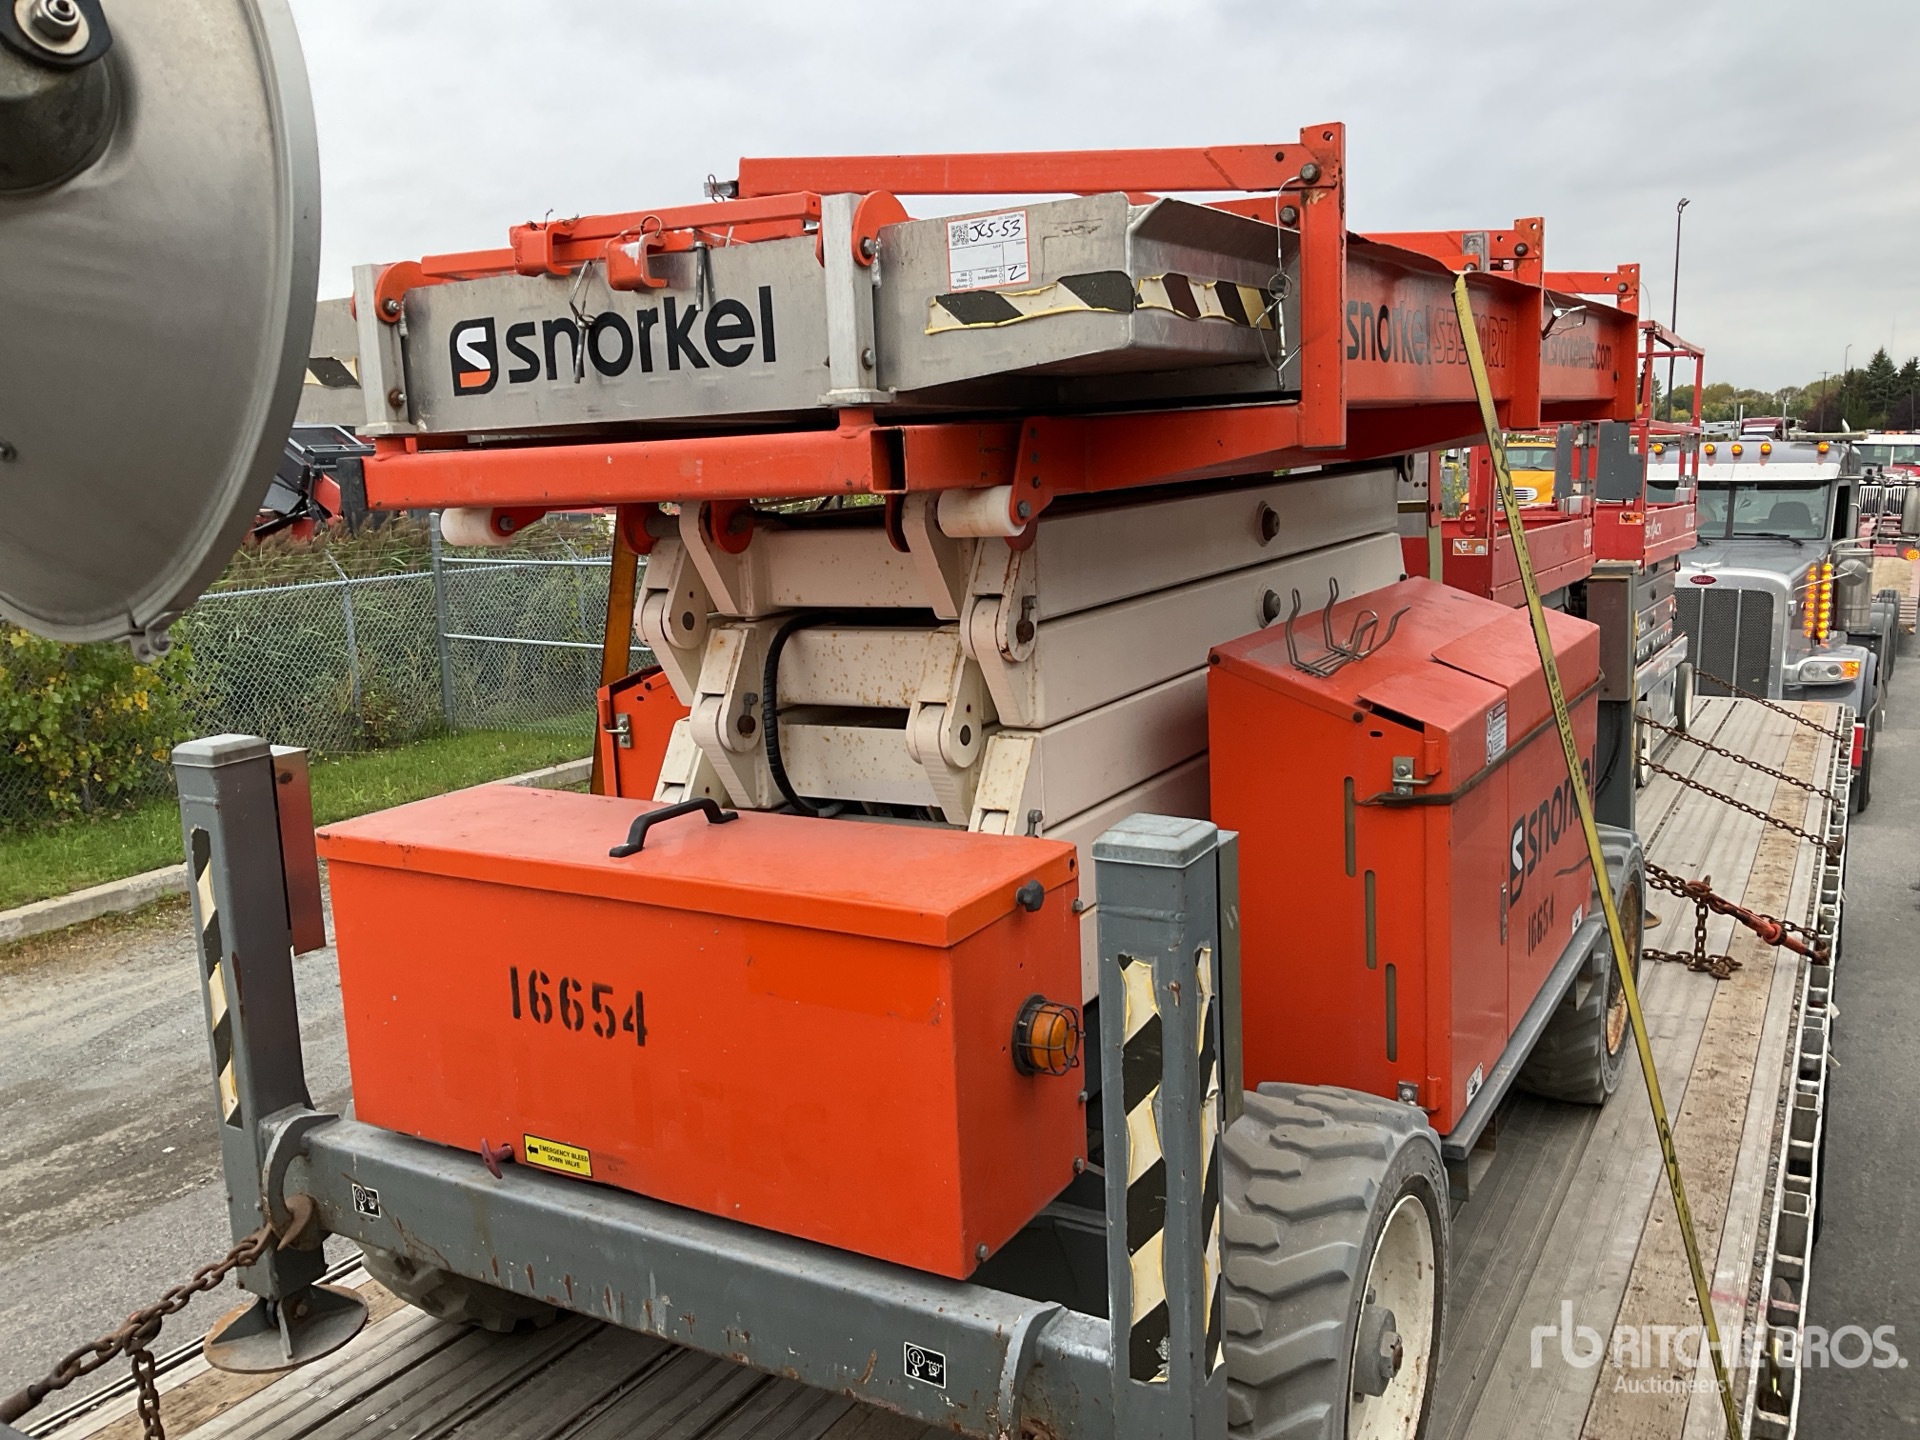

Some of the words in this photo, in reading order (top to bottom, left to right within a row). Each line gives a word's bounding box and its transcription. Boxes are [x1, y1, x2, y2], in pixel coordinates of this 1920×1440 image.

[505, 285, 776, 384] snorkel
[1346, 300, 1431, 365] snorkel
[1528, 892, 1554, 958] 16654
[510, 965, 648, 1047] 16654
[539, 1144, 570, 1157] EMERGENCY
[571, 1151, 588, 1163] BLEED
[547, 1154, 563, 1165] DOWN
[565, 1159, 581, 1168] VALVE
